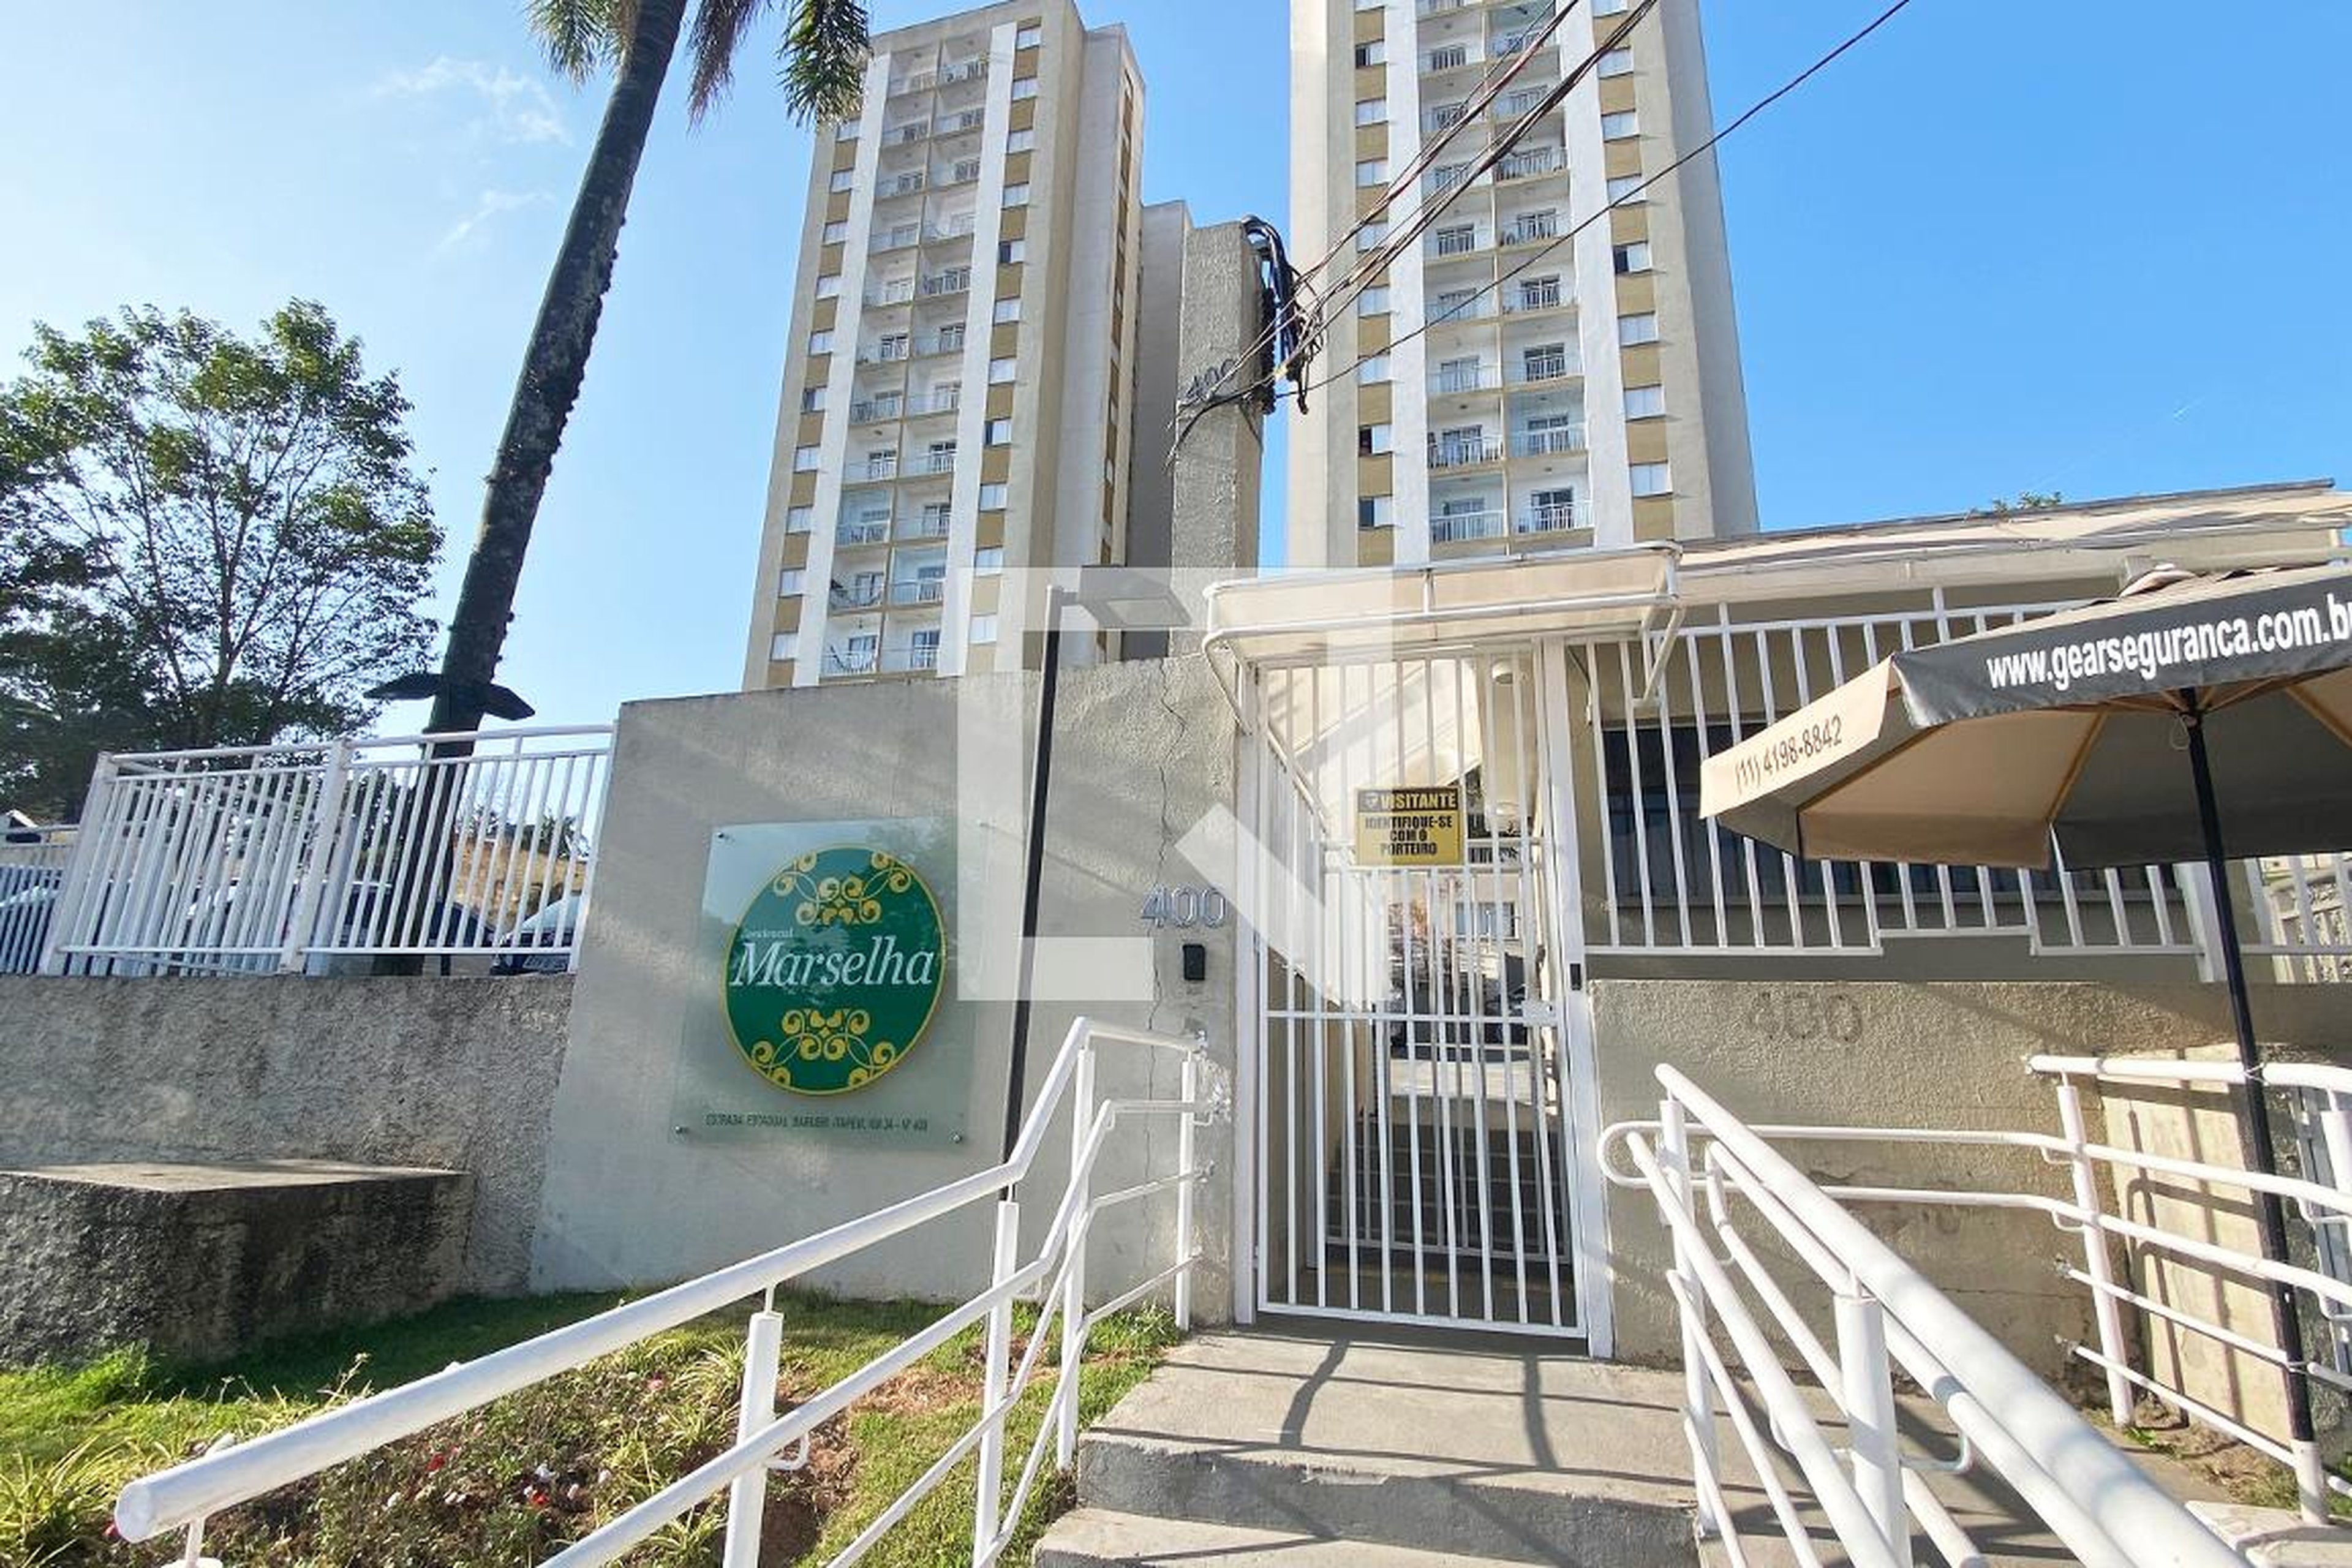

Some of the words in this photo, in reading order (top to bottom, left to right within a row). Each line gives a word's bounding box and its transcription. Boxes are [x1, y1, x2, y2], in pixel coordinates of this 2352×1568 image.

[1381, 793, 1457, 810] VISITANTE
[1390, 829, 1417, 842] COM
[1380, 843, 1438, 856] PORTEIRO
[1140, 884, 1226, 929] 400
[729, 934, 936, 987] Marselha
